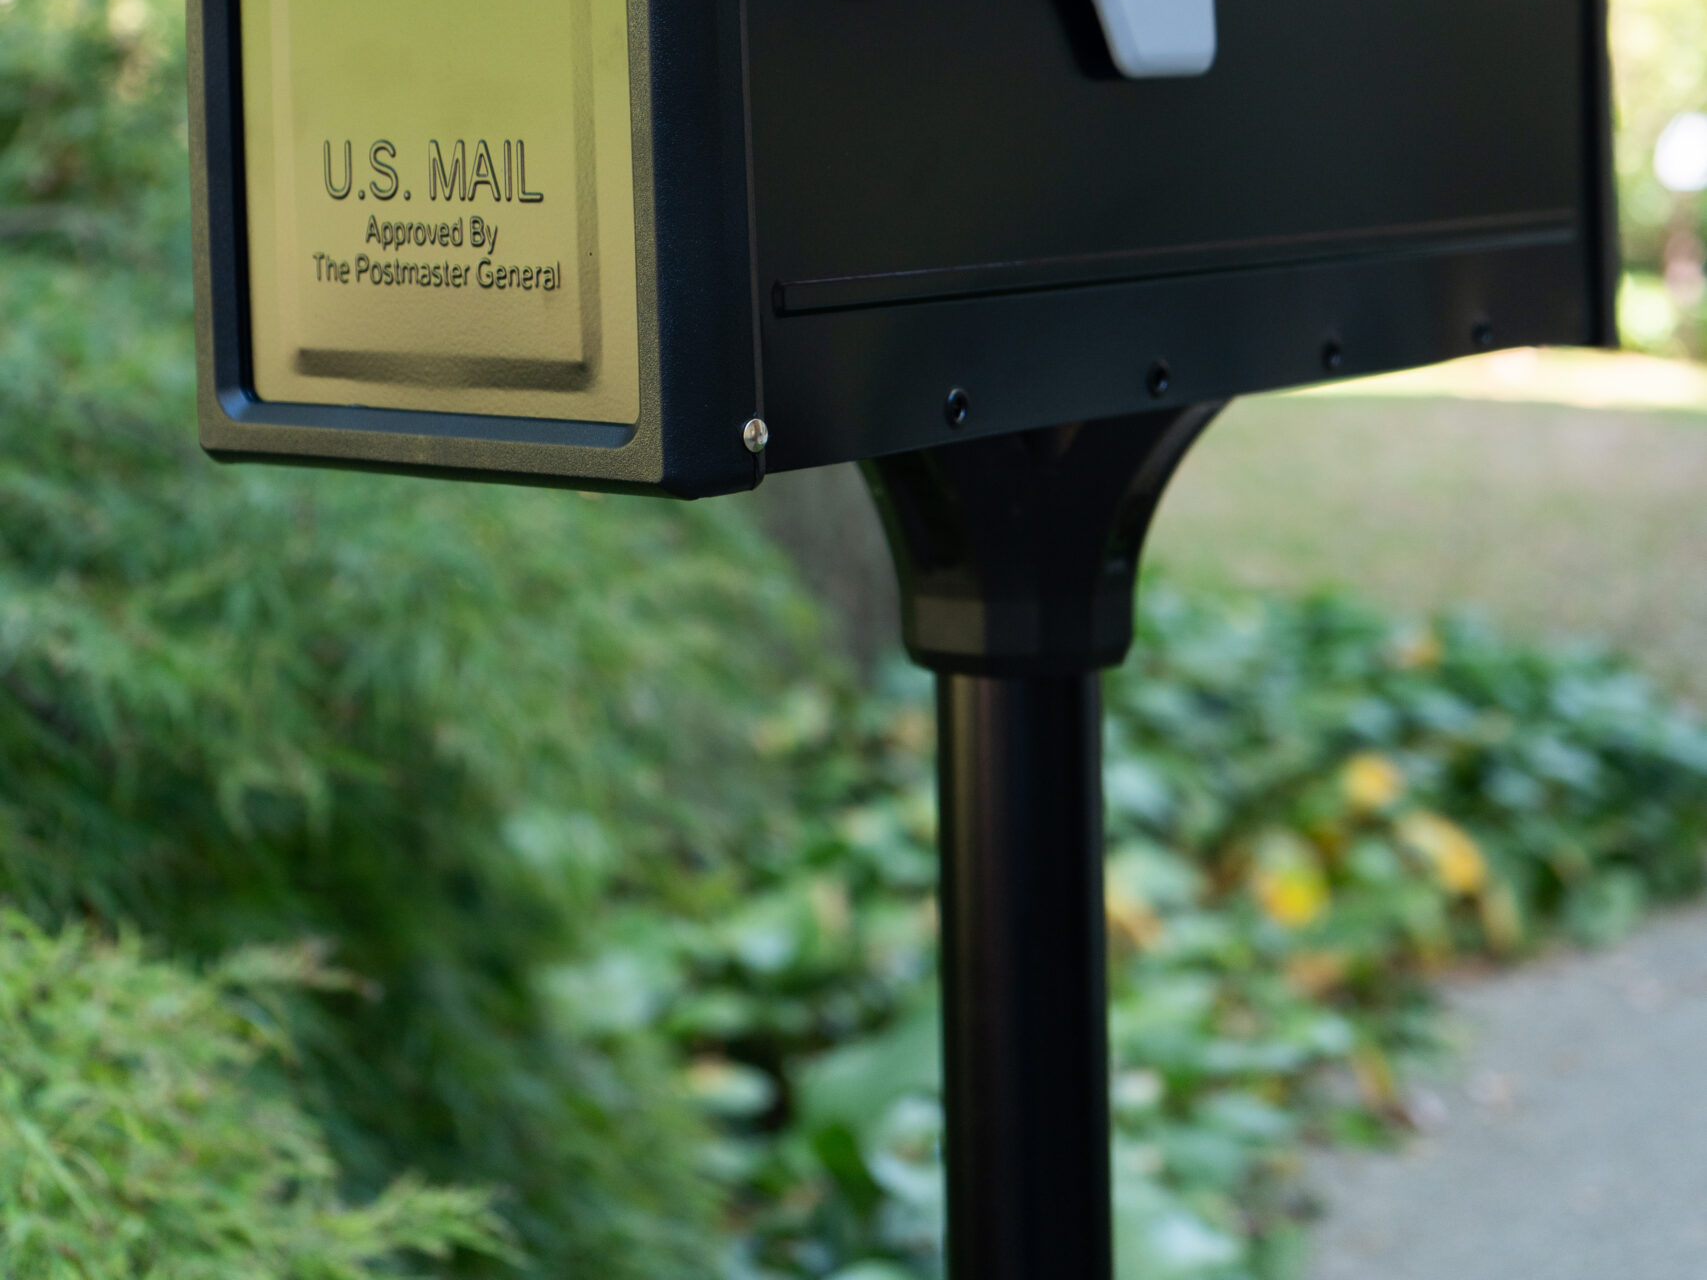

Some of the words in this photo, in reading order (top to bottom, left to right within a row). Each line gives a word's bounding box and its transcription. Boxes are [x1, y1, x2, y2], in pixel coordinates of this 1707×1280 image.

[323, 139, 411, 201] U.S.
[428, 139, 544, 203] MAIL
[366, 215, 463, 251] Approved
[470, 216, 498, 254] By
[313, 251, 350, 284] The
[355, 253, 470, 288] Postmaster
[476, 257, 562, 291] General
